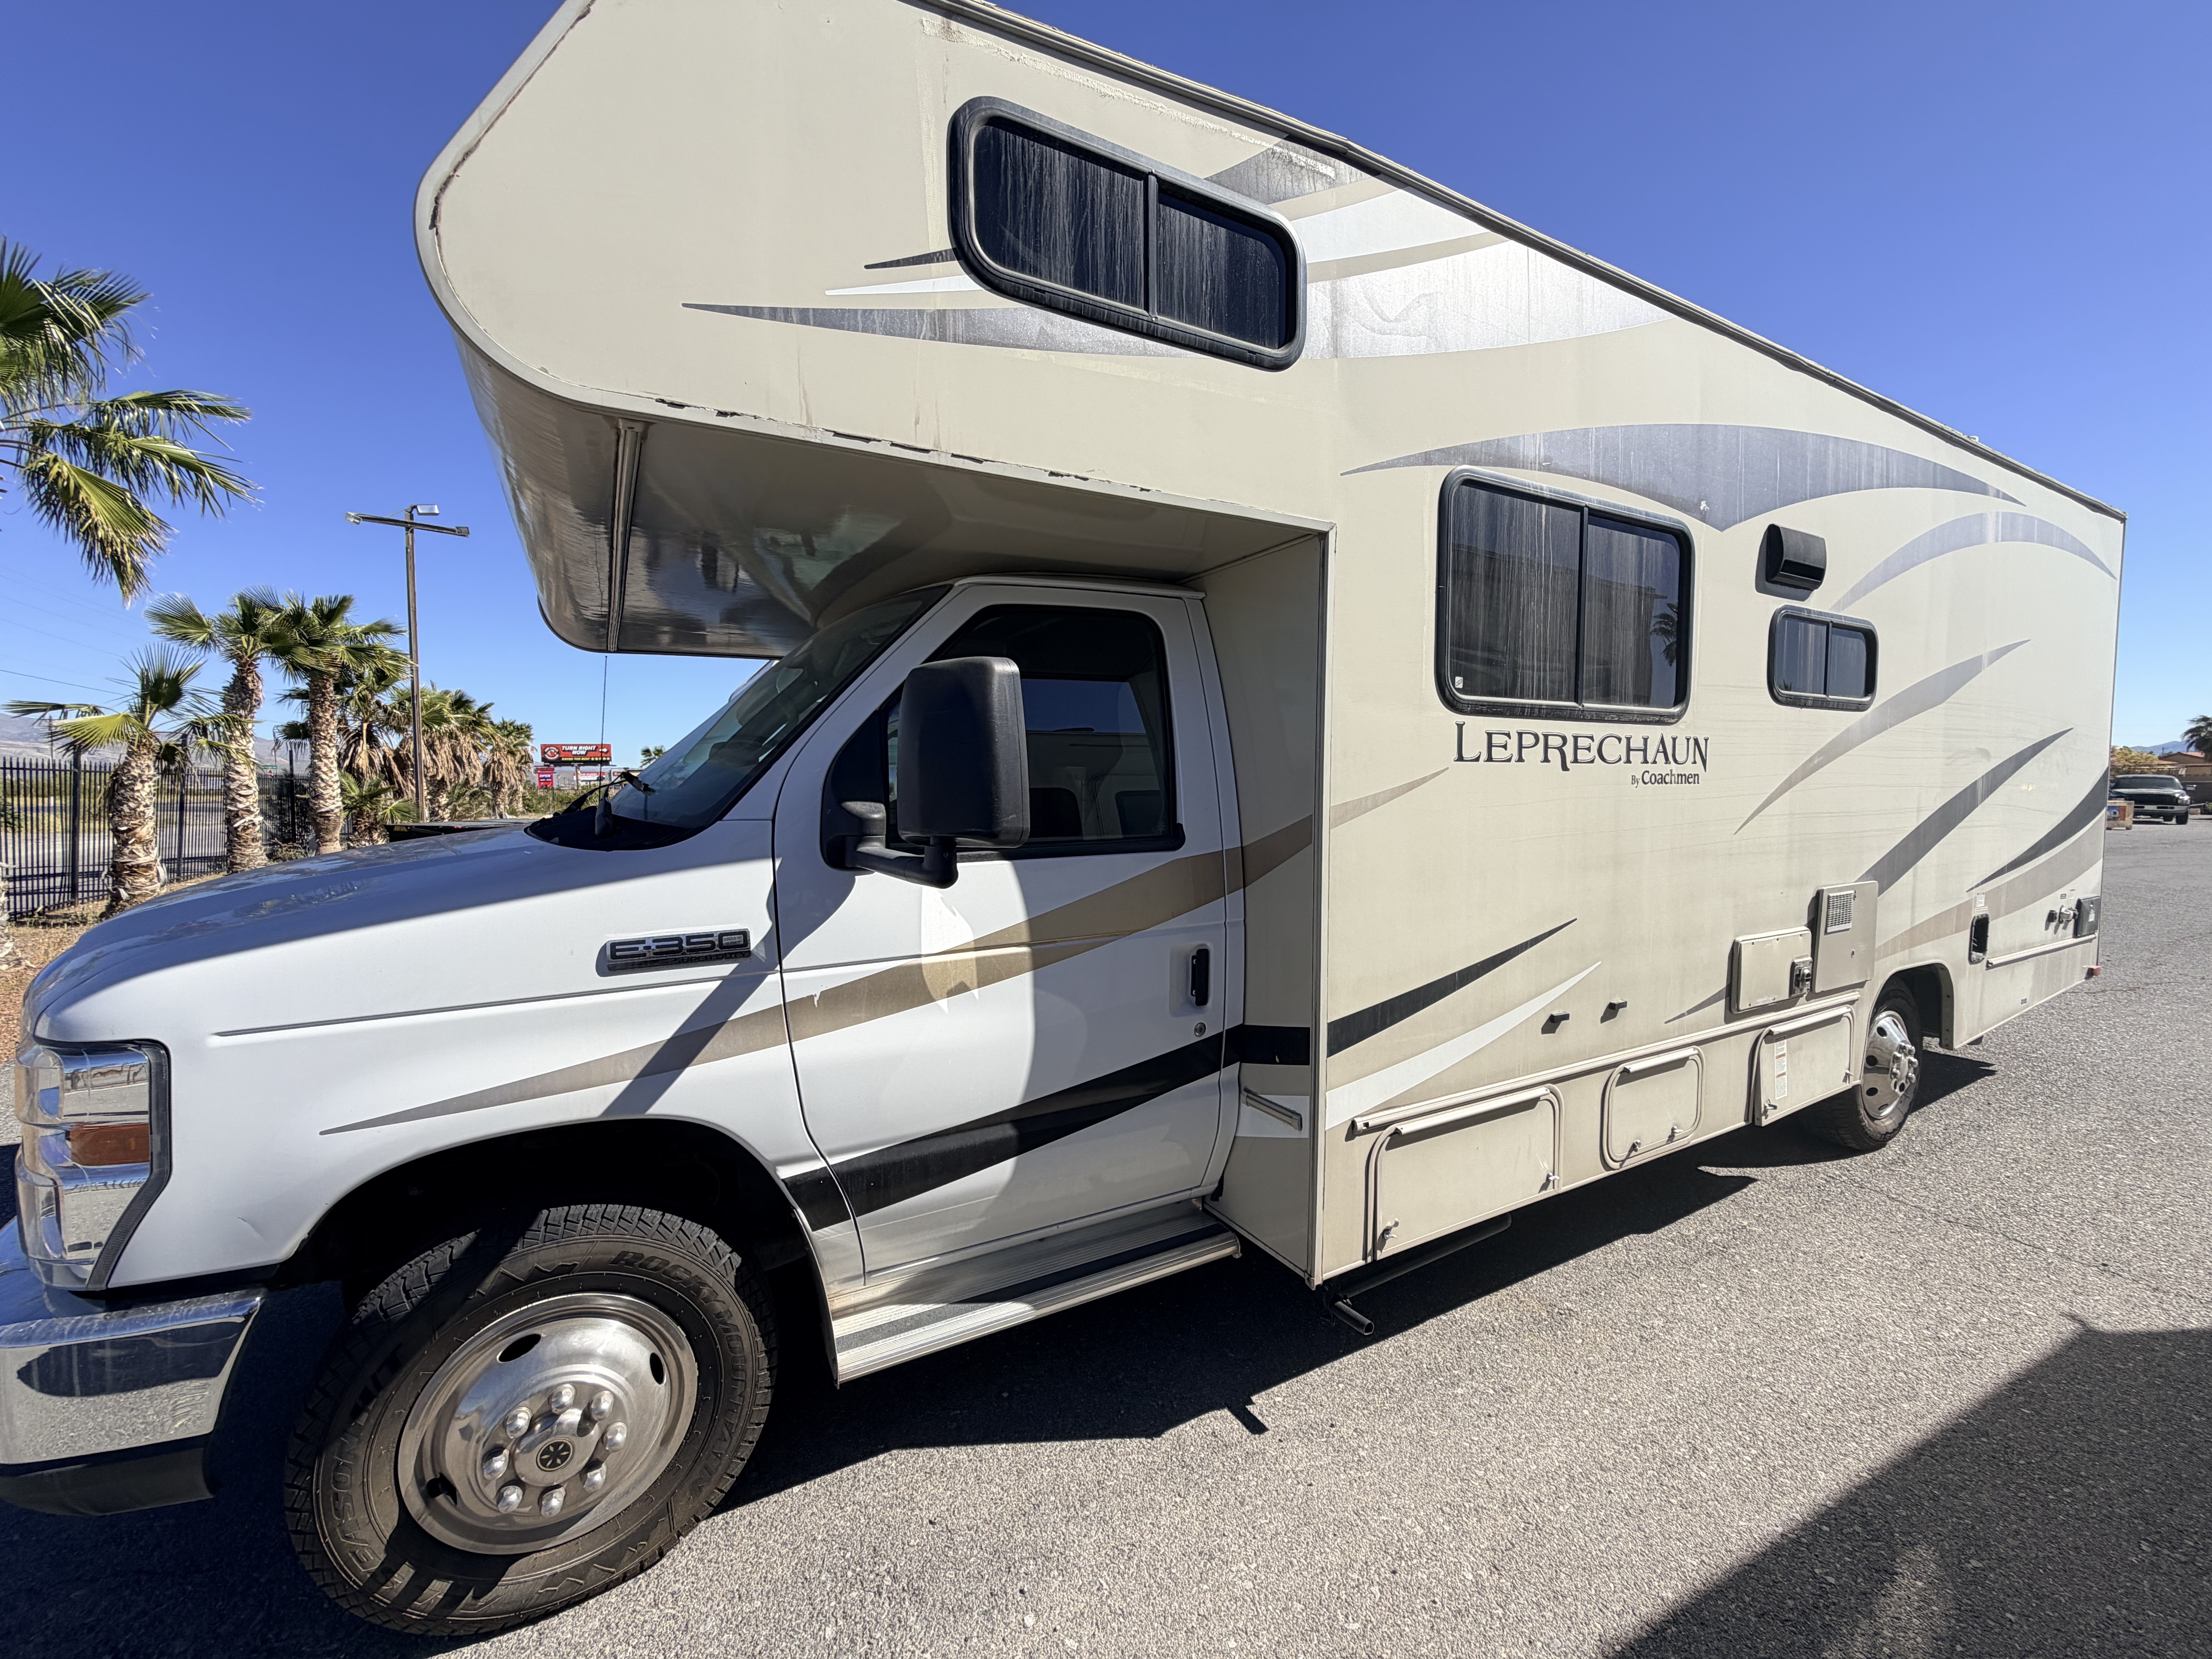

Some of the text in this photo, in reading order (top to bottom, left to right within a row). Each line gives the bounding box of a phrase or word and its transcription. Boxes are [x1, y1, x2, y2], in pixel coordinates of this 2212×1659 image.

[1453, 721, 1709, 772] LEPRECHAUN
[1631, 769, 1700, 788] By Coachmen
[610, 931, 748, 960] E-350
[673, 951, 747, 964] SUPER DUTY
[609, 1250, 746, 1496] ROCKY MOUNTAIN
